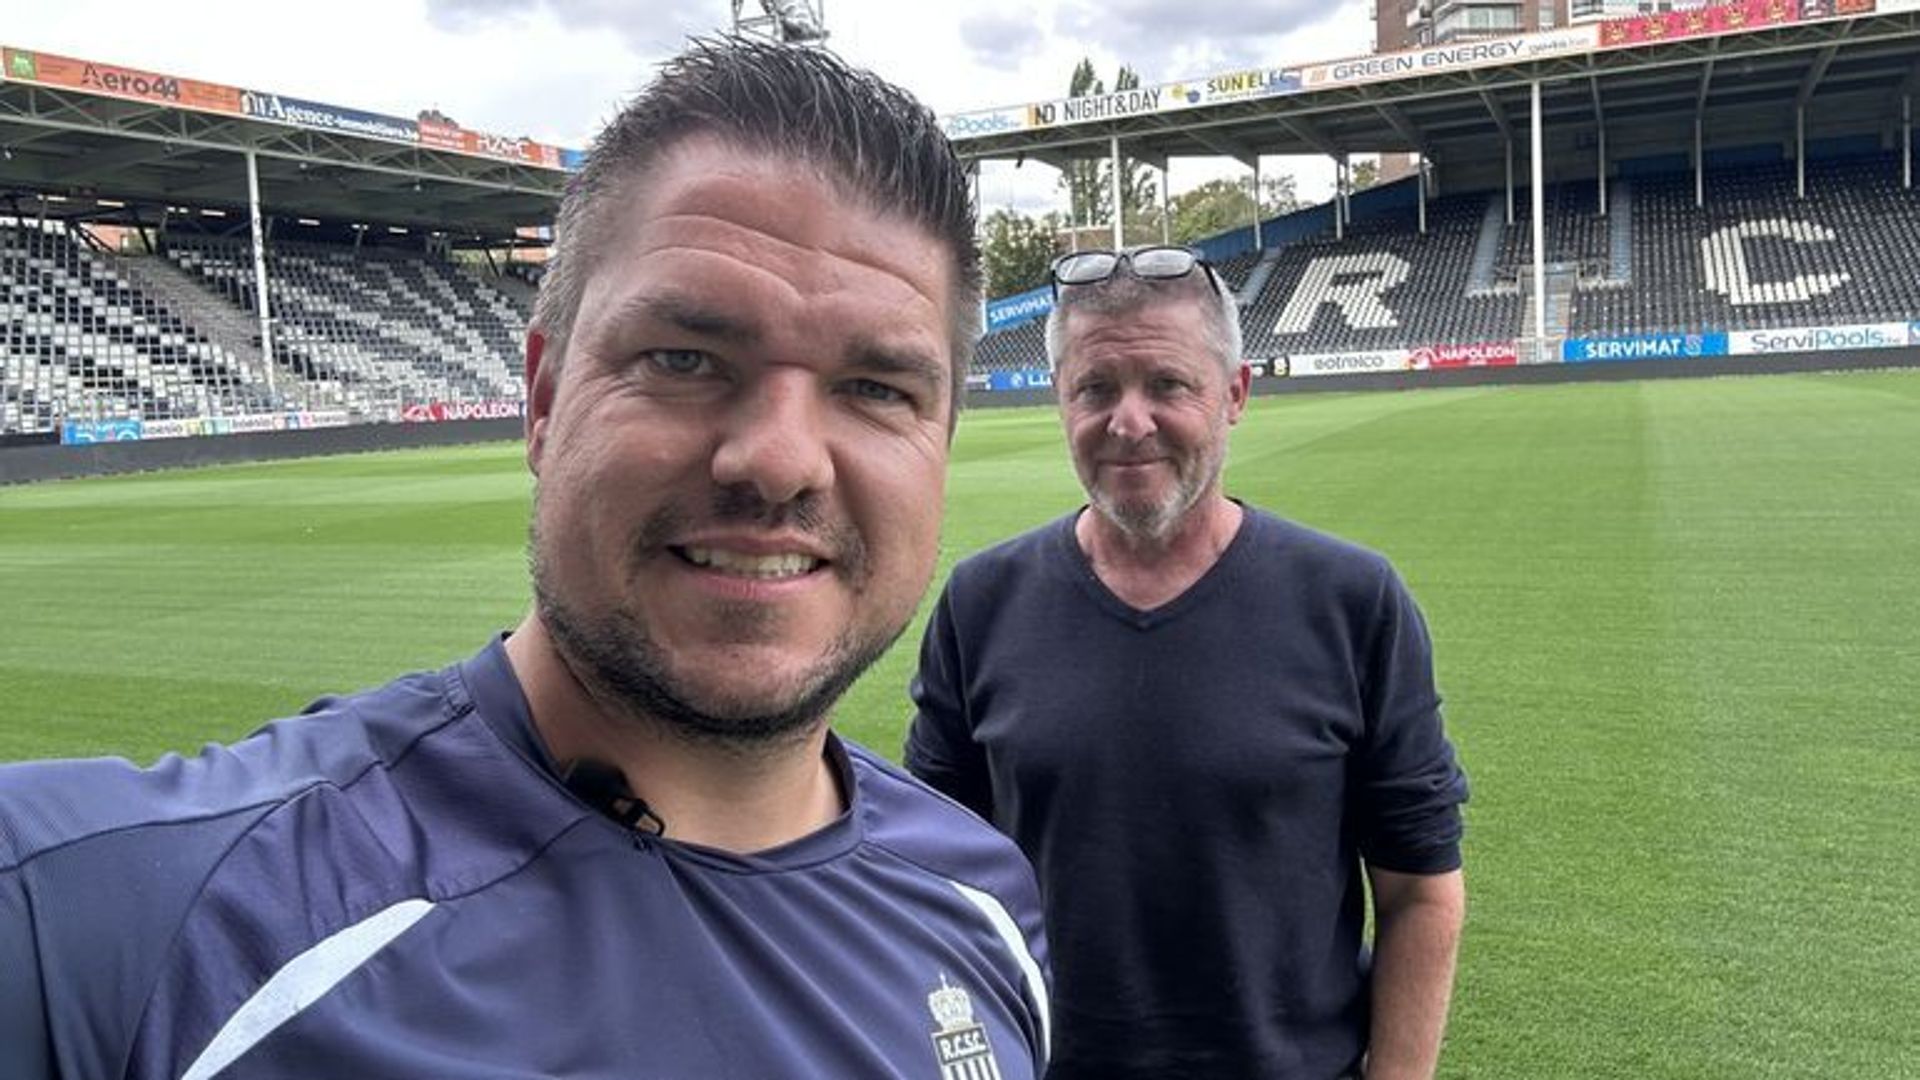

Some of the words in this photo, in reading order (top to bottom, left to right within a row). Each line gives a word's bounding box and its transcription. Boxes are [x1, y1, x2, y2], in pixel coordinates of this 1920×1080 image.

[1332, 55, 1413, 81] GREEN
[1421, 40, 1524, 67] ENERGY
[81, 62, 181, 100] Aero44
[1206, 73, 1243, 93] SUN
[1064, 87, 1161, 121] NIGHT&DAY
[1702, 218, 1851, 305] C
[1273, 253, 1410, 334] R
[1440, 344, 1516, 361] NAPOLEON
[1585, 338, 1682, 359] SERVIMAT
[443, 399, 520, 420] NAPOLEON
